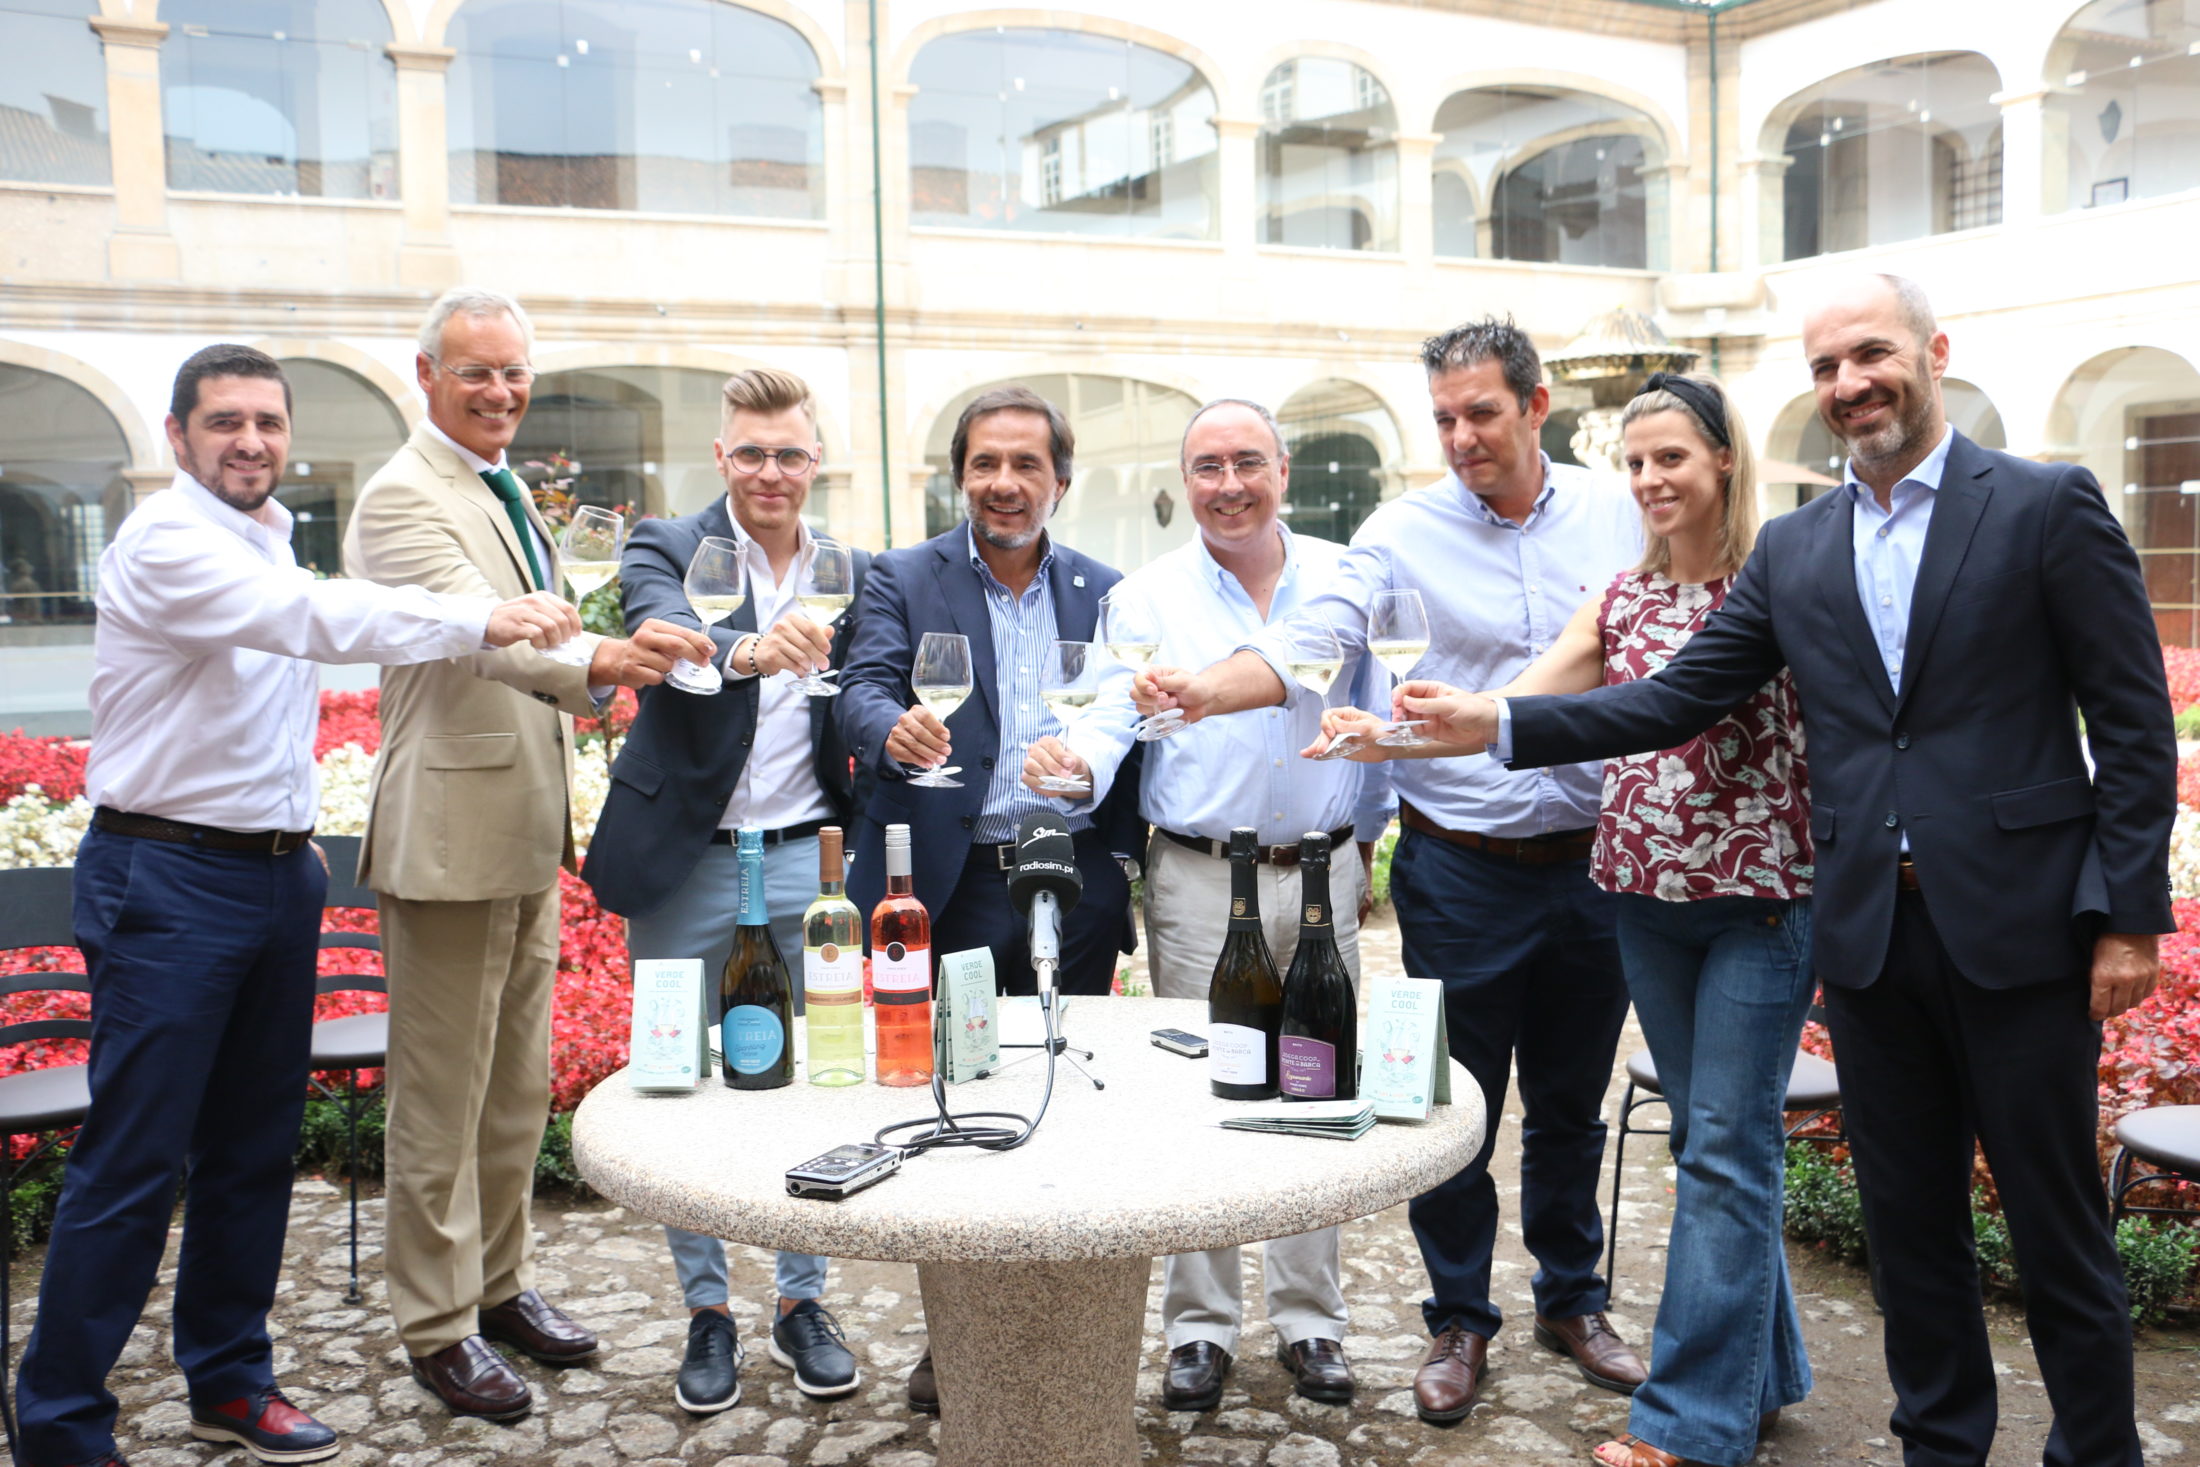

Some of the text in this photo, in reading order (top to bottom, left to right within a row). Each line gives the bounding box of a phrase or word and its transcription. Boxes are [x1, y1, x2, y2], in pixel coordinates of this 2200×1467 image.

[1019, 860, 1074, 874] radiosim.pt
[740, 867, 749, 914] ESTREIA
[961, 960, 983, 971] VERDE
[654, 970, 685, 979] VERDE
[963, 970, 983, 981] COOL
[655, 979, 682, 988] COOL
[1391, 990, 1422, 999] VERDE
[1391, 999, 1418, 1010] COOL
